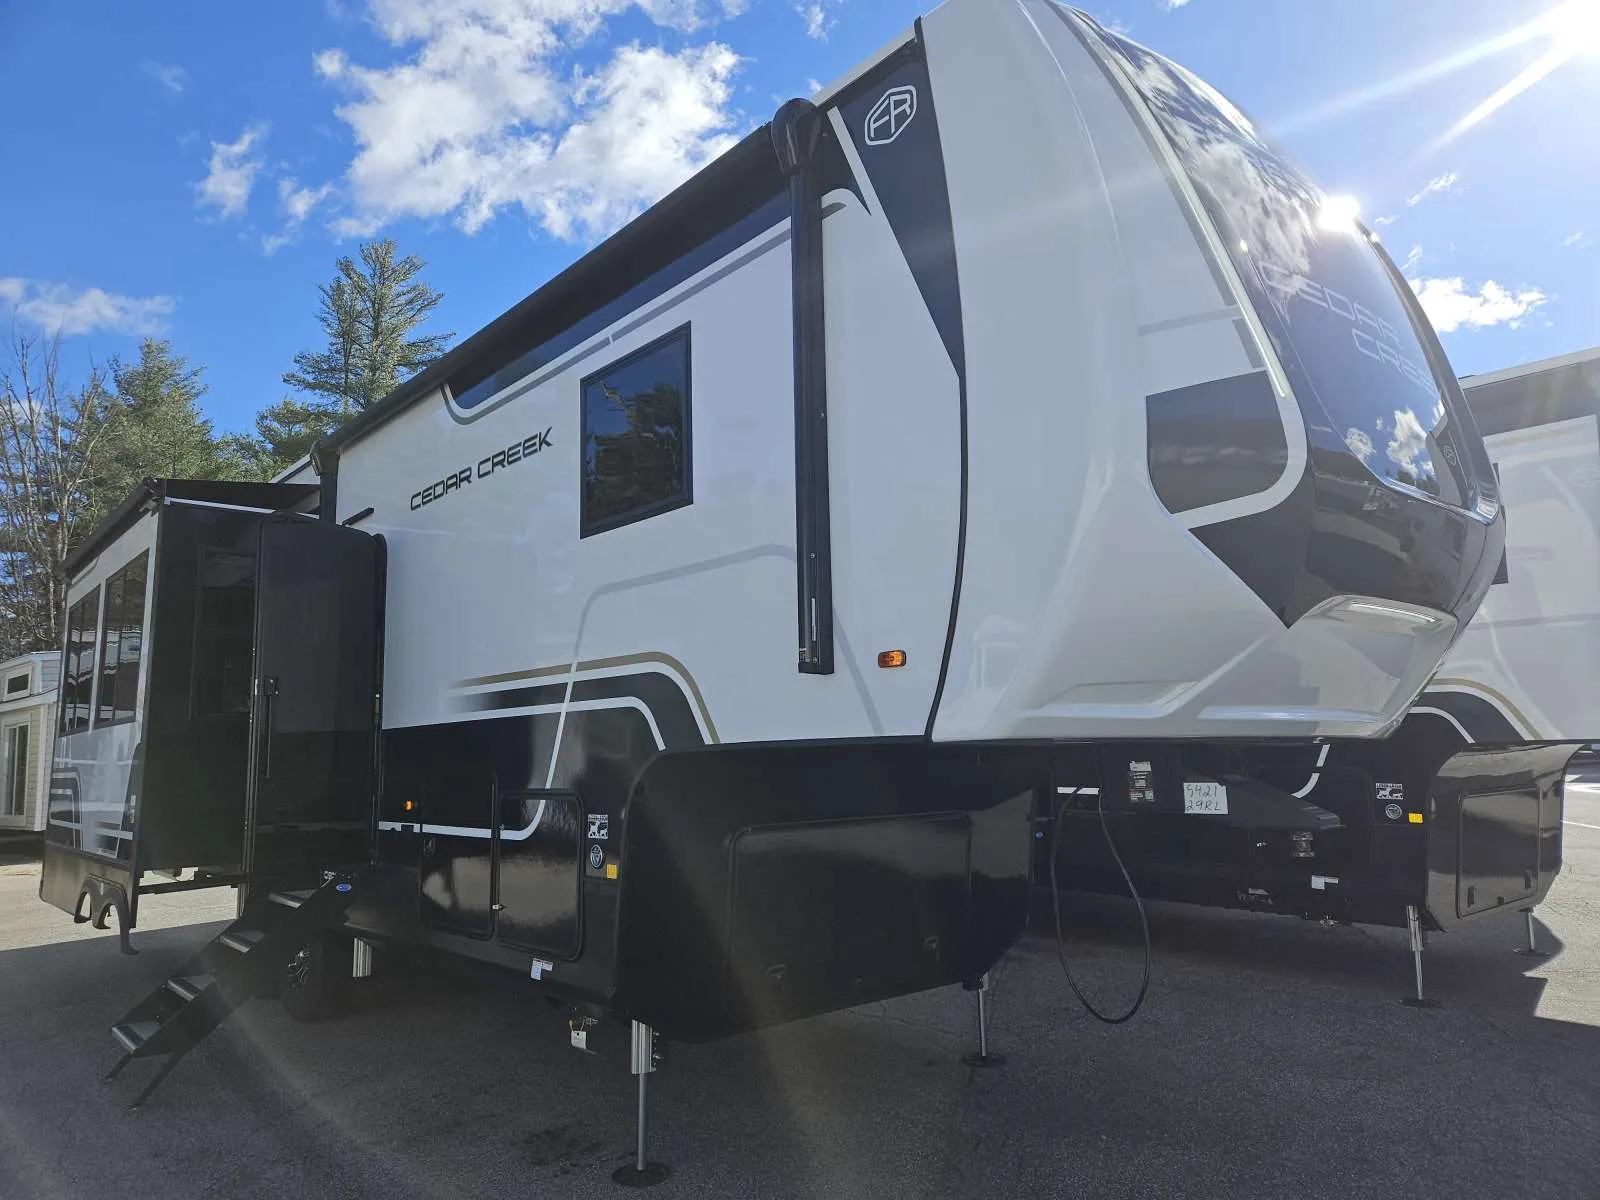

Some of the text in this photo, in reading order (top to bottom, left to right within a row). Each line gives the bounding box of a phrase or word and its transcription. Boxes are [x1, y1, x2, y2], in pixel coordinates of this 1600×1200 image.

[1259, 261, 1402, 350] CEDAR
[410, 426, 553, 511] CEDAR CREEK
